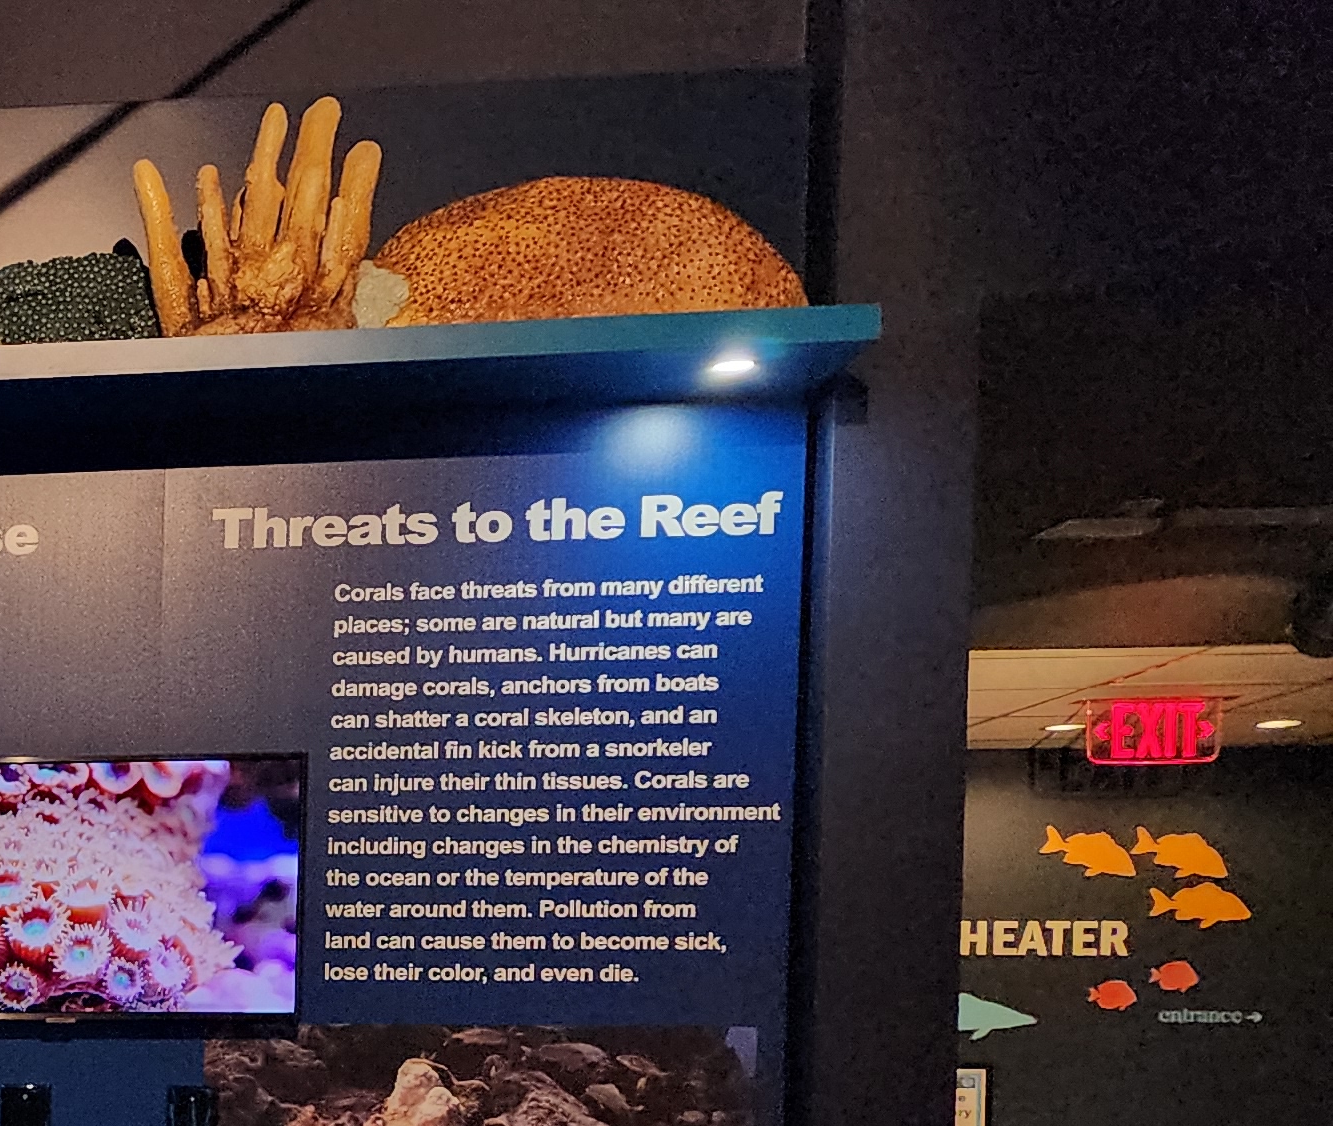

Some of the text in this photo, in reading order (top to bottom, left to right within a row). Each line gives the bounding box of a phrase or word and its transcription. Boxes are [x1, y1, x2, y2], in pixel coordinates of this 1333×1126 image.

[212, 491, 784, 549] Threats to the Reef
[335, 574, 764, 602] Corals face threats from many different
[333, 609, 752, 638] places; some are natural but many are
[333, 642, 718, 668] caused by humans. Hurricanes can
[331, 673, 719, 700] damage corals, anchors from boats
[331, 705, 717, 728] can shatter a coral skeleton, and an
[1111, 702, 1205, 758] EXIT
[329, 737, 712, 760] accidental fin kick from a snorkeler
[1158, 1009, 1243, 1024] entrance
